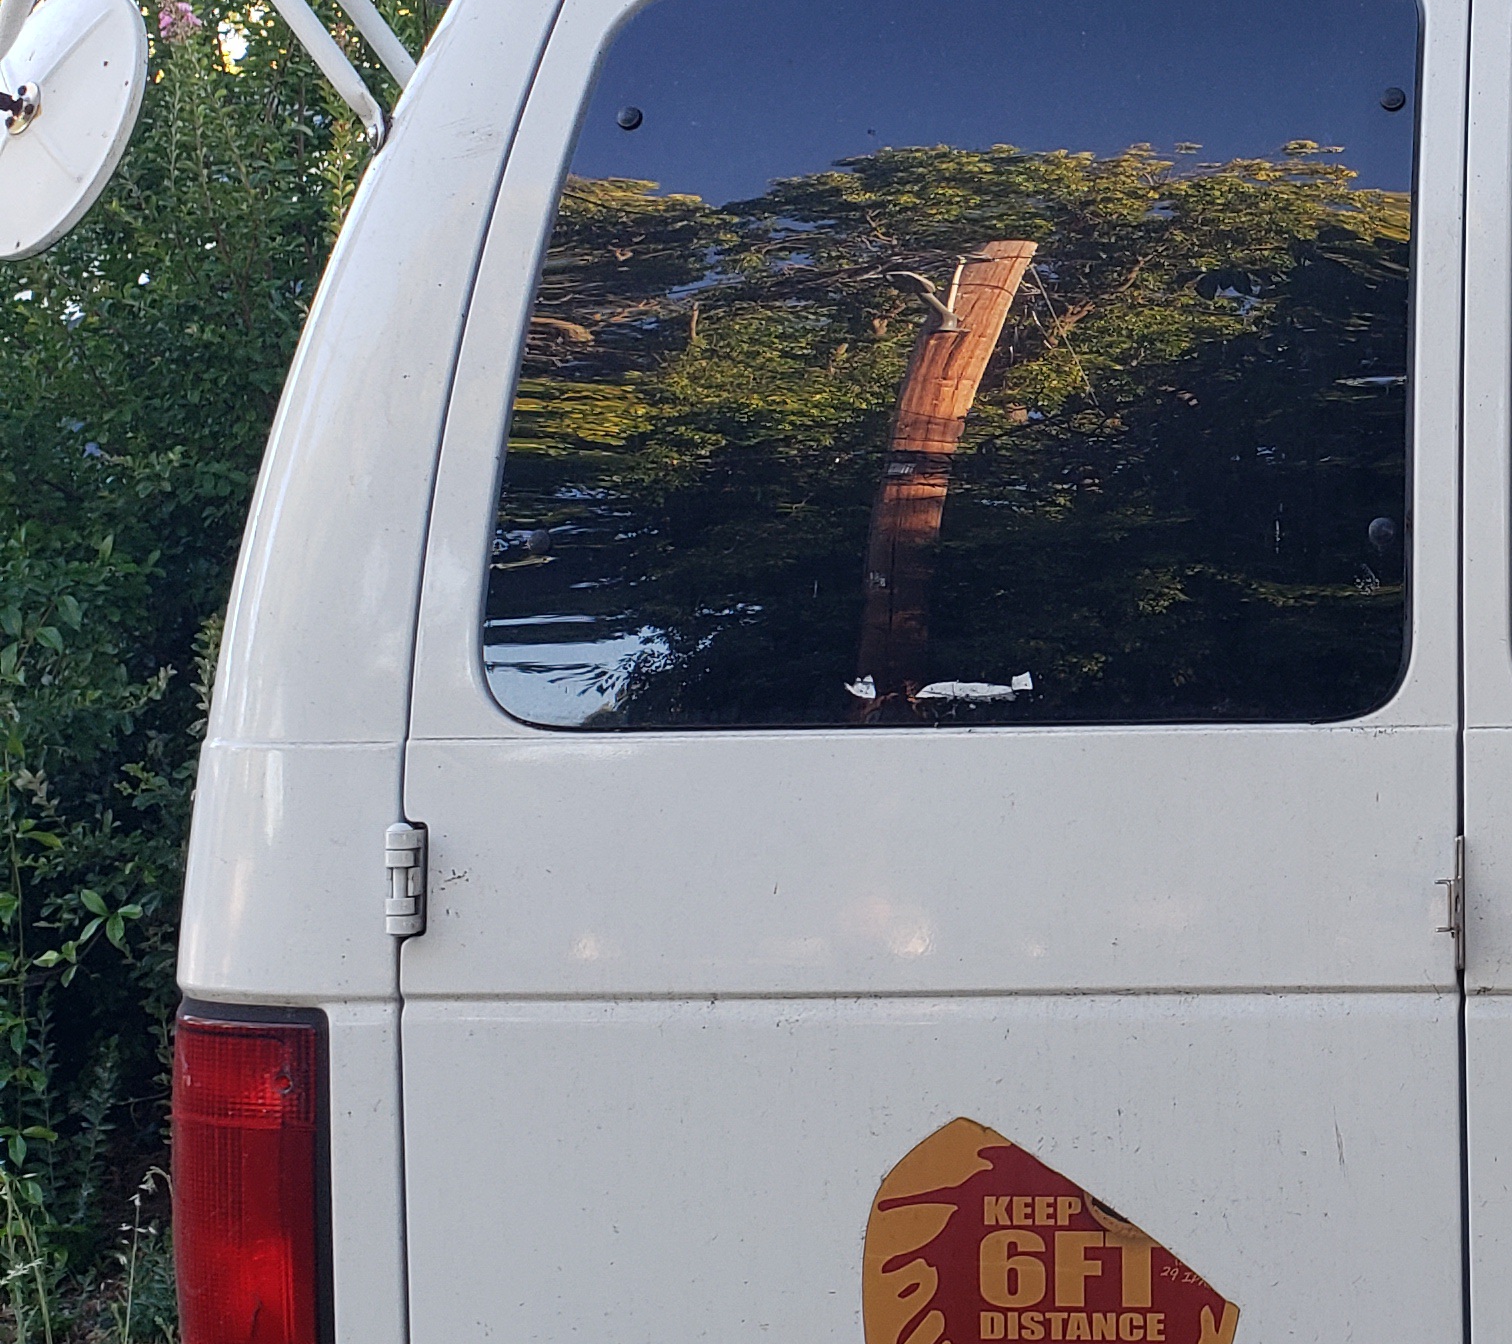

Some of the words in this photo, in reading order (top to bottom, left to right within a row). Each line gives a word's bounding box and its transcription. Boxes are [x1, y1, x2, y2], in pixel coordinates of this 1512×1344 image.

[983, 1196, 1082, 1226] KEEP
[979, 1229, 1162, 1308] 6FT
[979, 1311, 1166, 1341] DISTANCE
